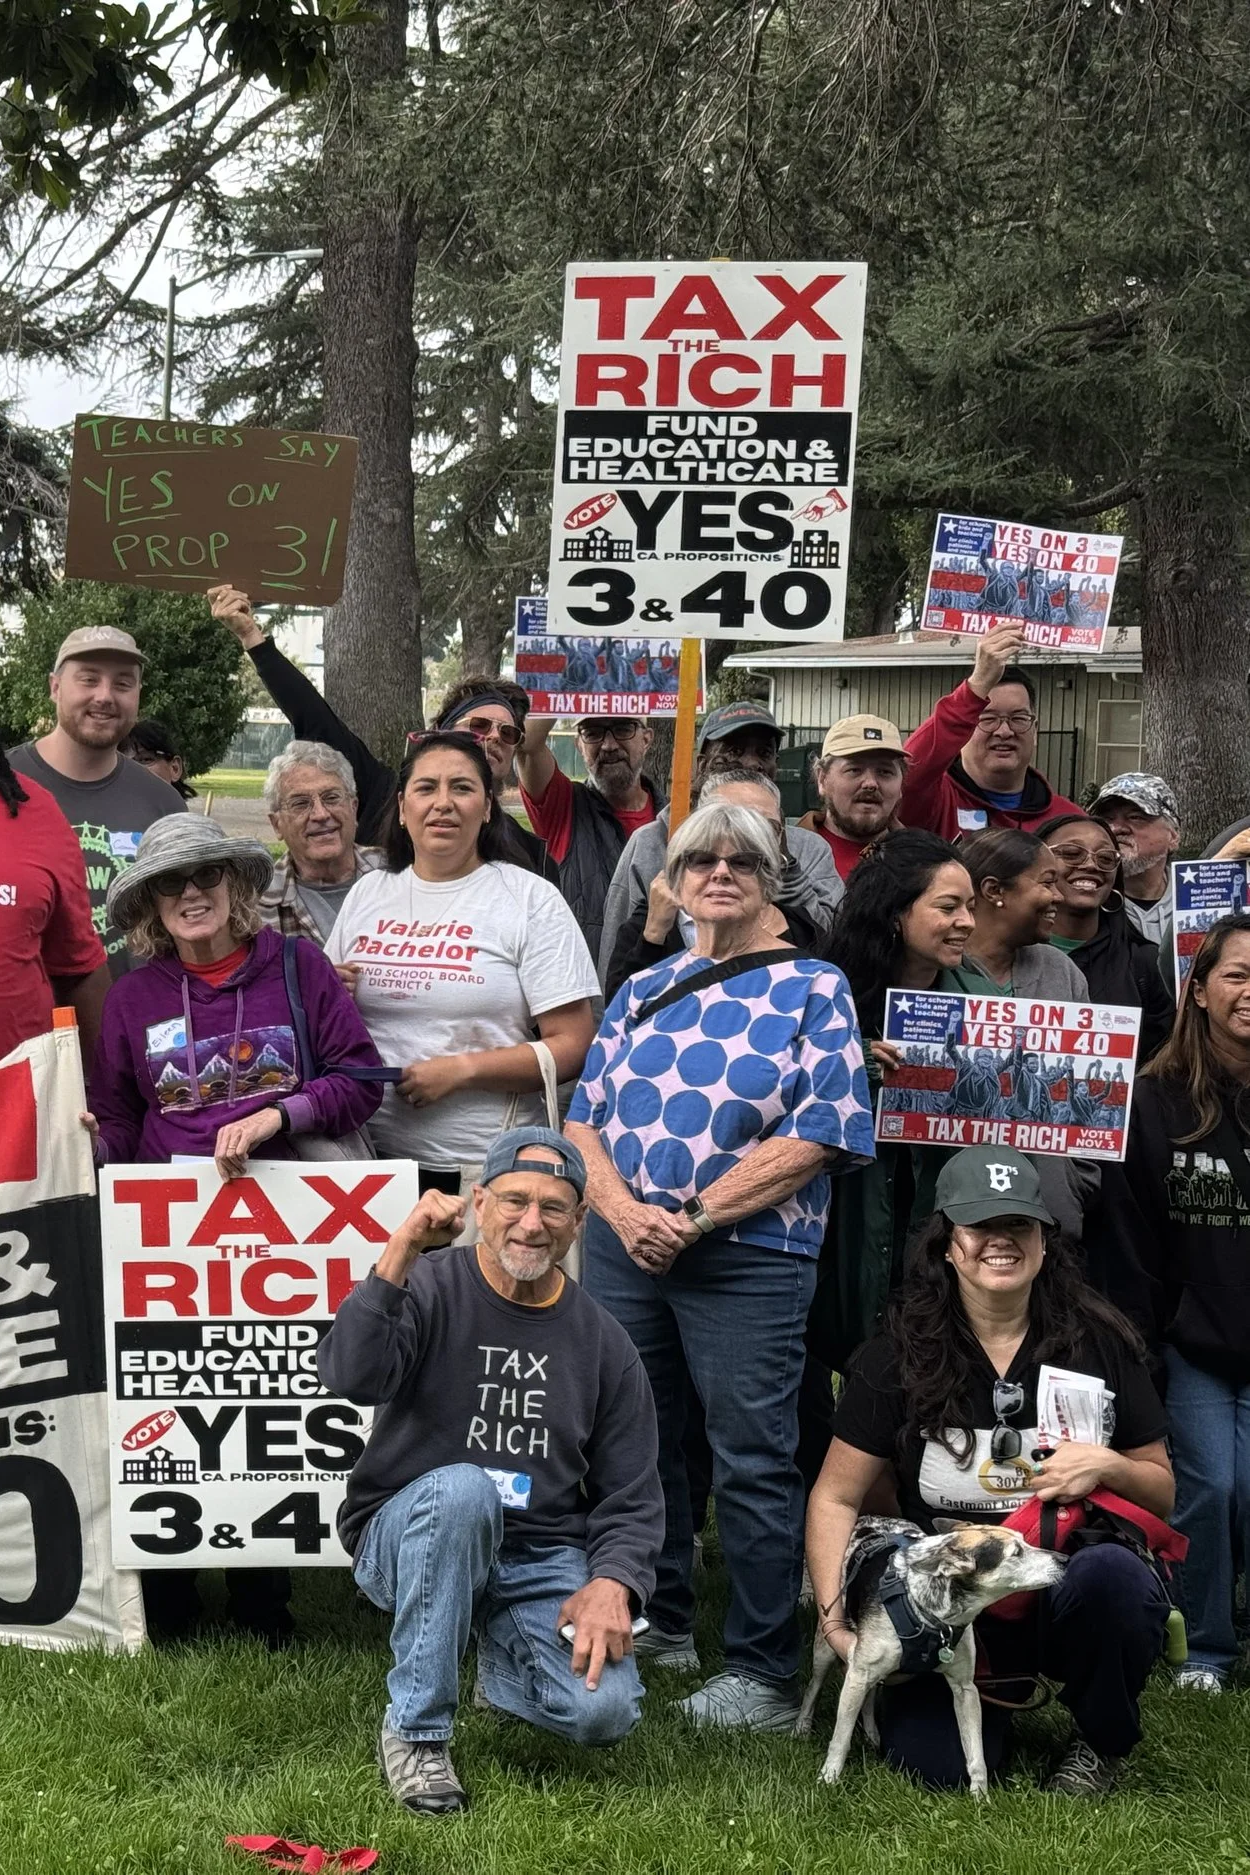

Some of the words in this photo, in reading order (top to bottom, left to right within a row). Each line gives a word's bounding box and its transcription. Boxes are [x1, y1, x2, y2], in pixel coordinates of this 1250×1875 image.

[575, 275, 847, 340] TAX
[668, 339, 720, 352] THE
[575, 353, 847, 408] RICH
[647, 416, 758, 436] FUND
[80, 417, 244, 450] TEACHERS
[279, 435, 340, 468] SAY
[568, 438, 797, 459] EDUCATION
[805, 439, 835, 460] &
[569, 461, 839, 482] HEALTHCARE
[83, 466, 174, 523] YES
[227, 482, 280, 508] ON
[566, 493, 616, 528] VOTE
[615, 490, 795, 553] YES
[111, 532, 230, 570] PROP
[997, 525, 1033, 545] YES
[1041, 533, 1068, 551] ON
[1076, 537, 1088, 553] 3
[994, 542, 1029, 563] YES
[1036, 550, 1065, 569] ON
[1071, 555, 1098, 573] 40
[567, 568, 636, 626] 3
[640, 599, 675, 622] &
[681, 571, 832, 630] 40
[961, 612, 991, 634] TAX
[1024, 622, 1062, 646] RICH
[1071, 628, 1095, 637] VOTE
[547, 694, 576, 713] TAX
[579, 694, 608, 714] THE
[611, 695, 649, 714] RICH
[353, 935, 478, 961] Bachelor
[368, 978, 422, 990] DISTRICT
[425, 981, 432, 991] 6
[385, 969, 434, 980] SCHOOL
[439, 972, 485, 985] BOARD
[967, 999, 1016, 1022] YES
[1030, 1004, 1065, 1026] ON
[1078, 1008, 1093, 1029] 3
[964, 1024, 1014, 1048] YES
[1026, 1028, 1062, 1052] ON
[1073, 1032, 1110, 1056] 40
[926, 1116, 966, 1142] TAX
[970, 1120, 1009, 1146] THE
[1015, 1124, 1067, 1151] RICH
[1076, 1138, 1105, 1148] NOV.
[1108, 1140, 1115, 1149] 3
[1080, 1129, 1112, 1139] VOTE
[113, 1174, 396, 1247] TAX
[216, 1245, 271, 1258] THE
[202, 1326, 318, 1347] FUND
[478, 1345, 549, 1381] TAX
[477, 1383, 547, 1419] THE
[123, 1411, 175, 1449] VOTE
[175, 1405, 365, 1472] YES
[466, 1415, 549, 1459] RICH
[940, 1496, 997, 1510] Eastmont
[130, 1491, 203, 1555] 3
[209, 1524, 247, 1549] &
